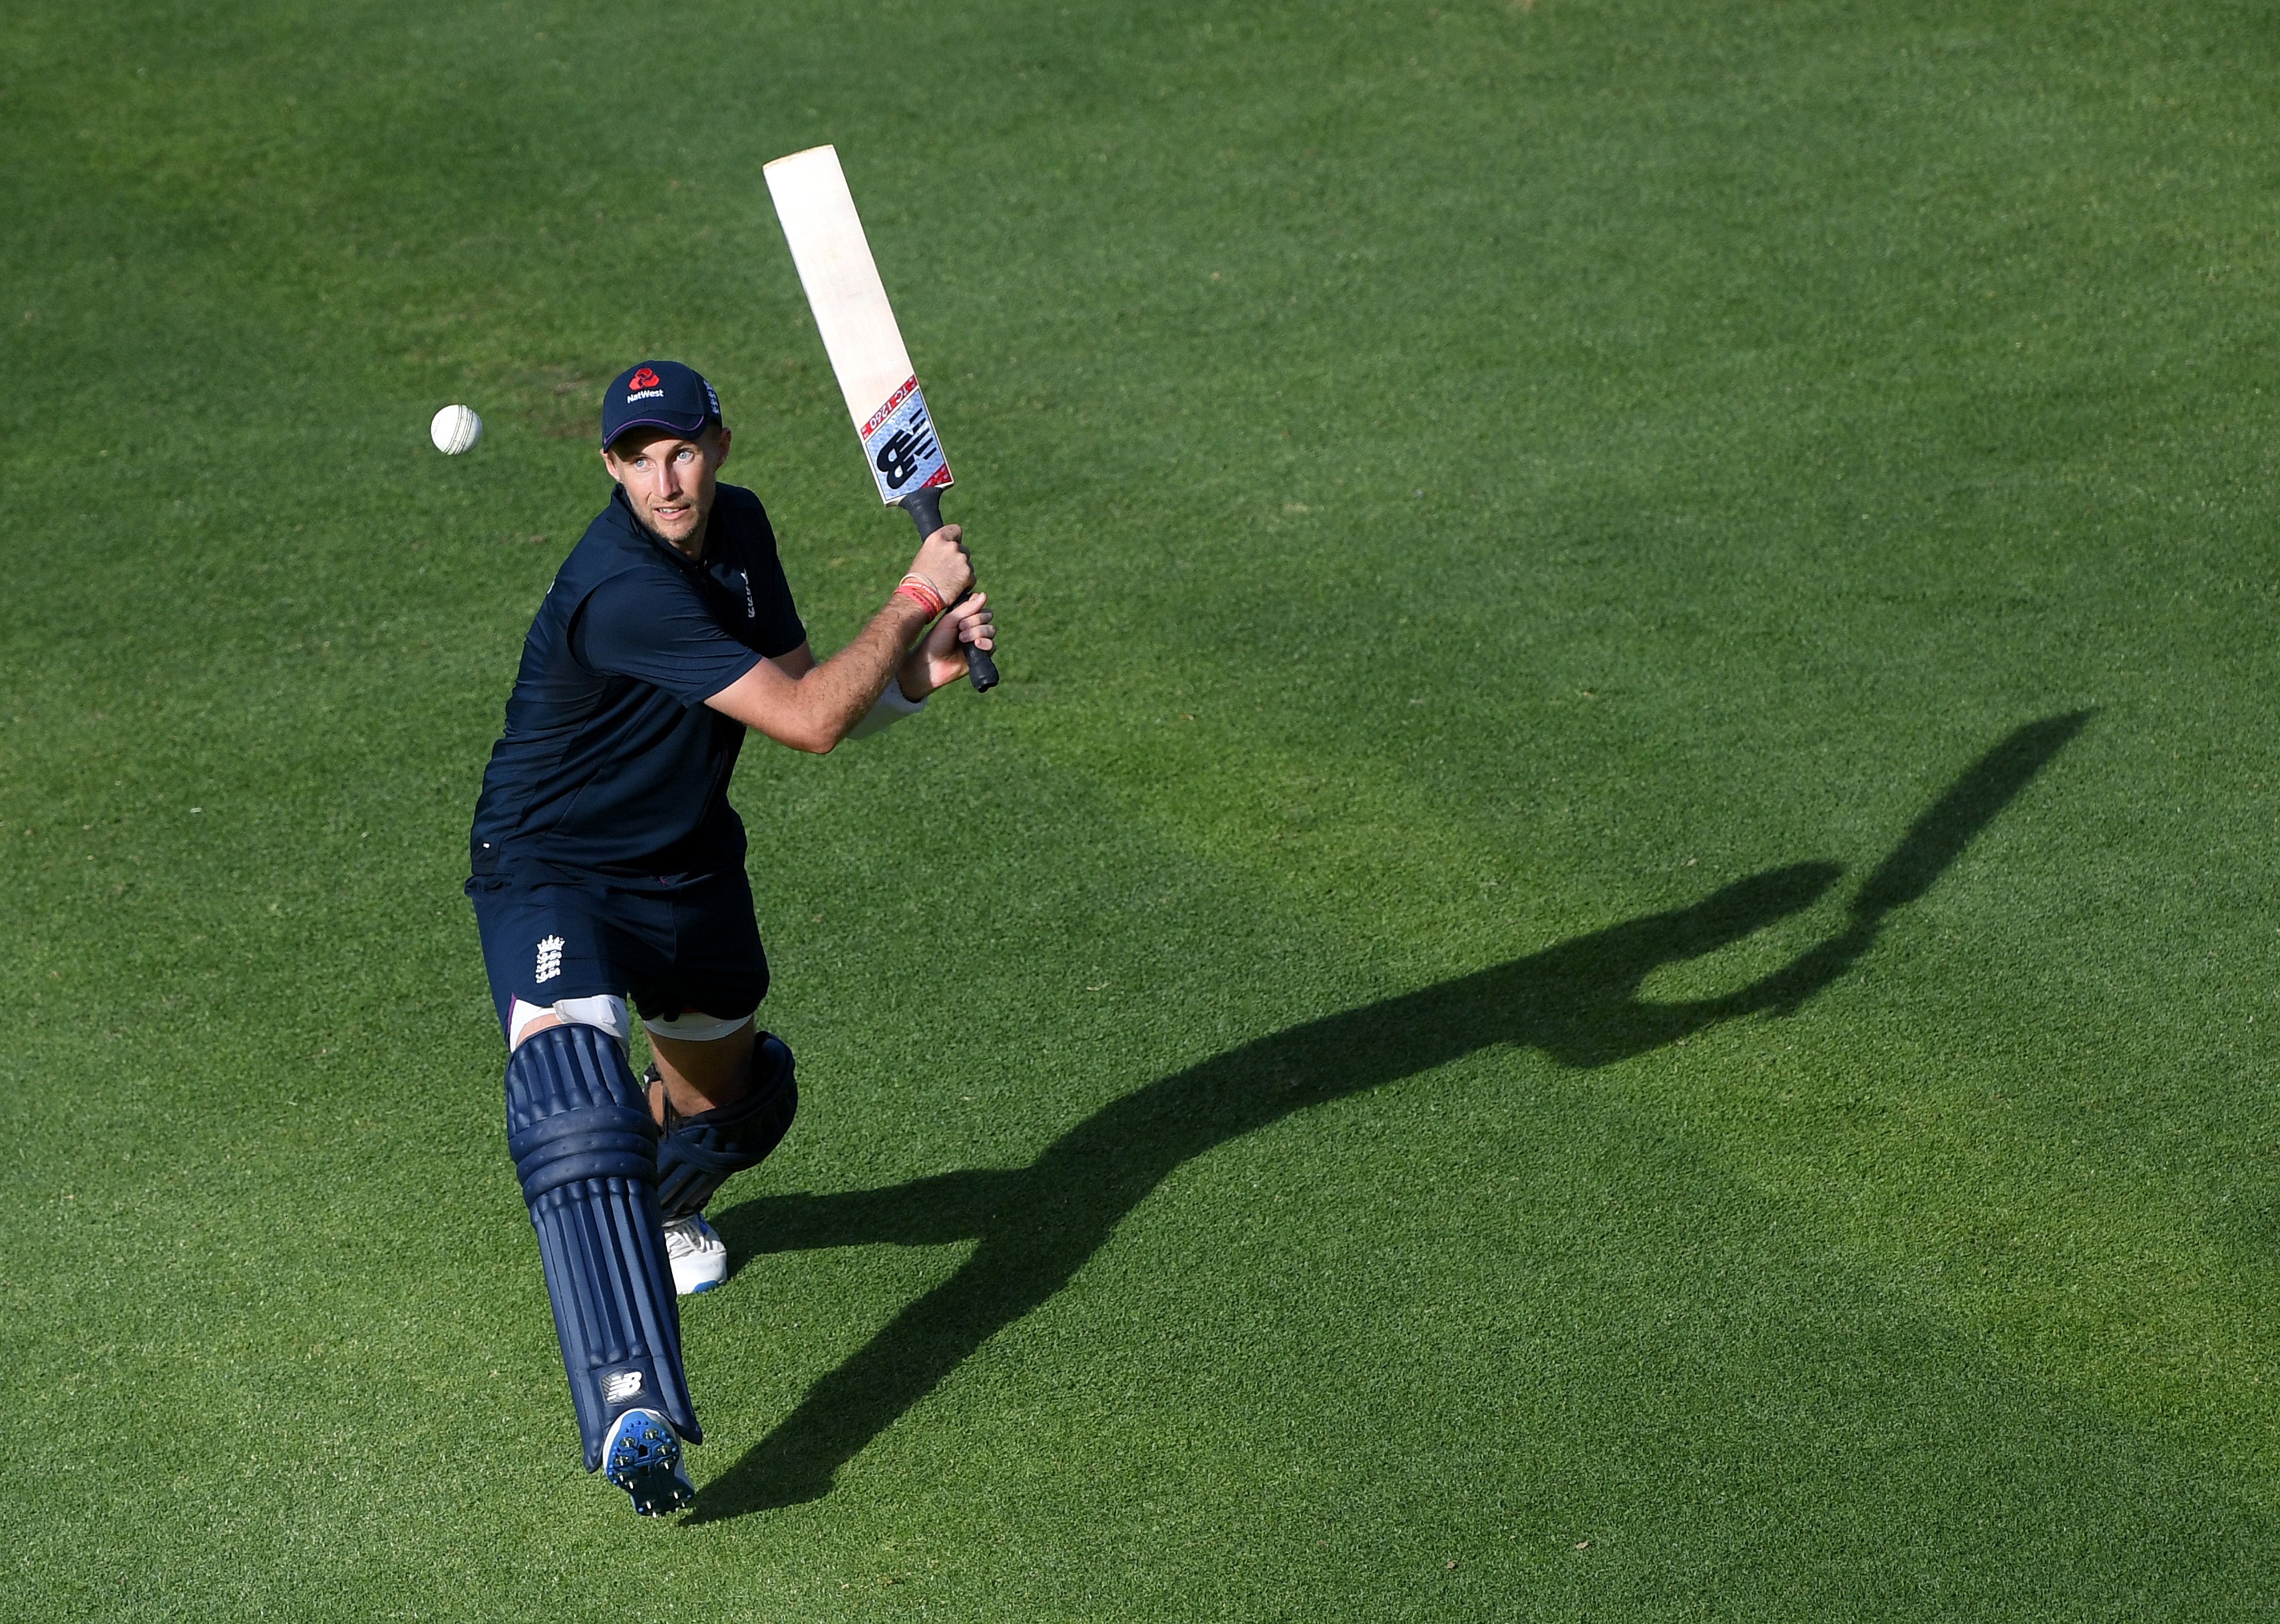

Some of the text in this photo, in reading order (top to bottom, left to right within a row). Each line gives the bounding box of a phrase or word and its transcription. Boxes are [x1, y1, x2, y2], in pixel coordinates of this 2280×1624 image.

[628, 389, 664, 403] NatWest
[869, 385, 908, 429] TC 1260
